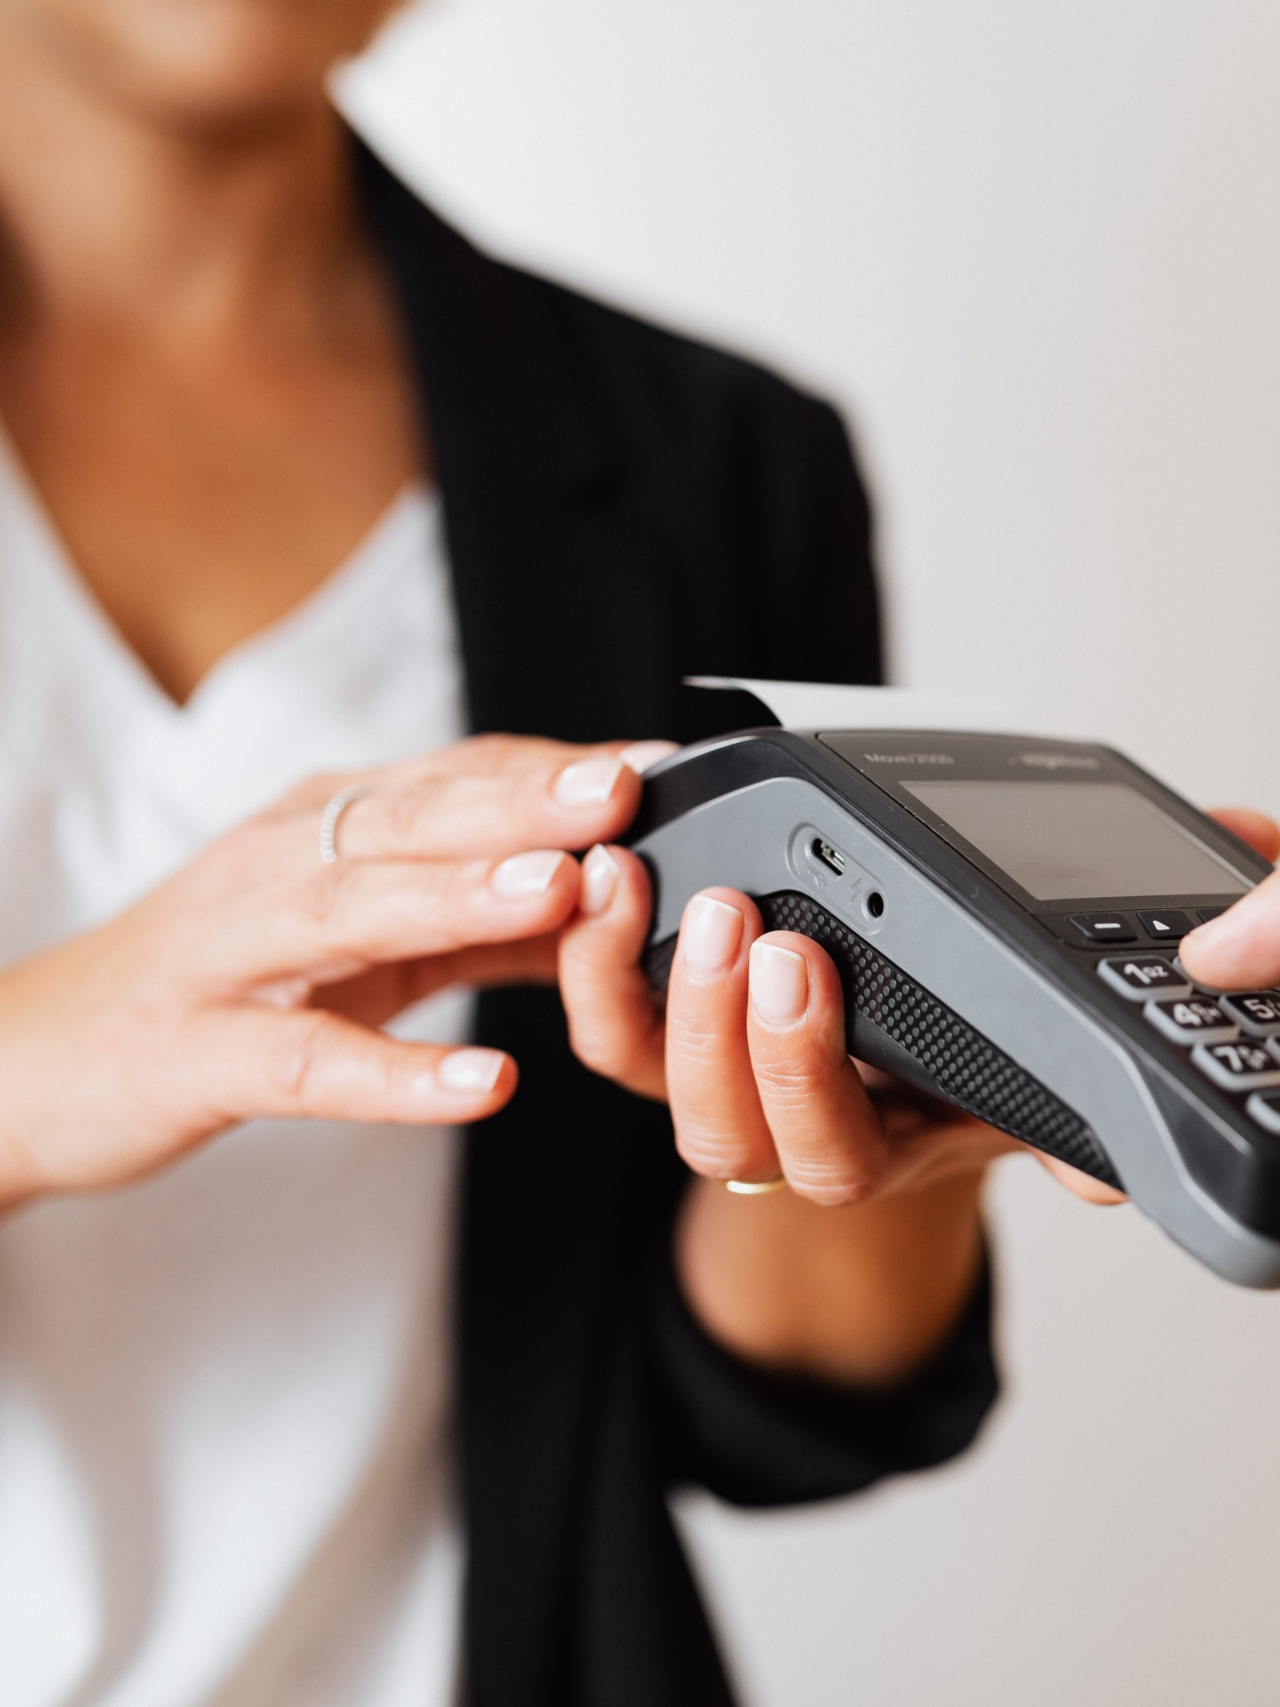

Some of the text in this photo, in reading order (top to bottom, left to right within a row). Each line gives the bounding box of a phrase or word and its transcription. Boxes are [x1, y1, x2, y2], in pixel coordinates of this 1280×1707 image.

[1123, 963, 1152, 985] 1
[1173, 1003, 1202, 1027] 4
[1242, 999, 1276, 1019] 5
[1212, 1045, 1244, 1073] 7
